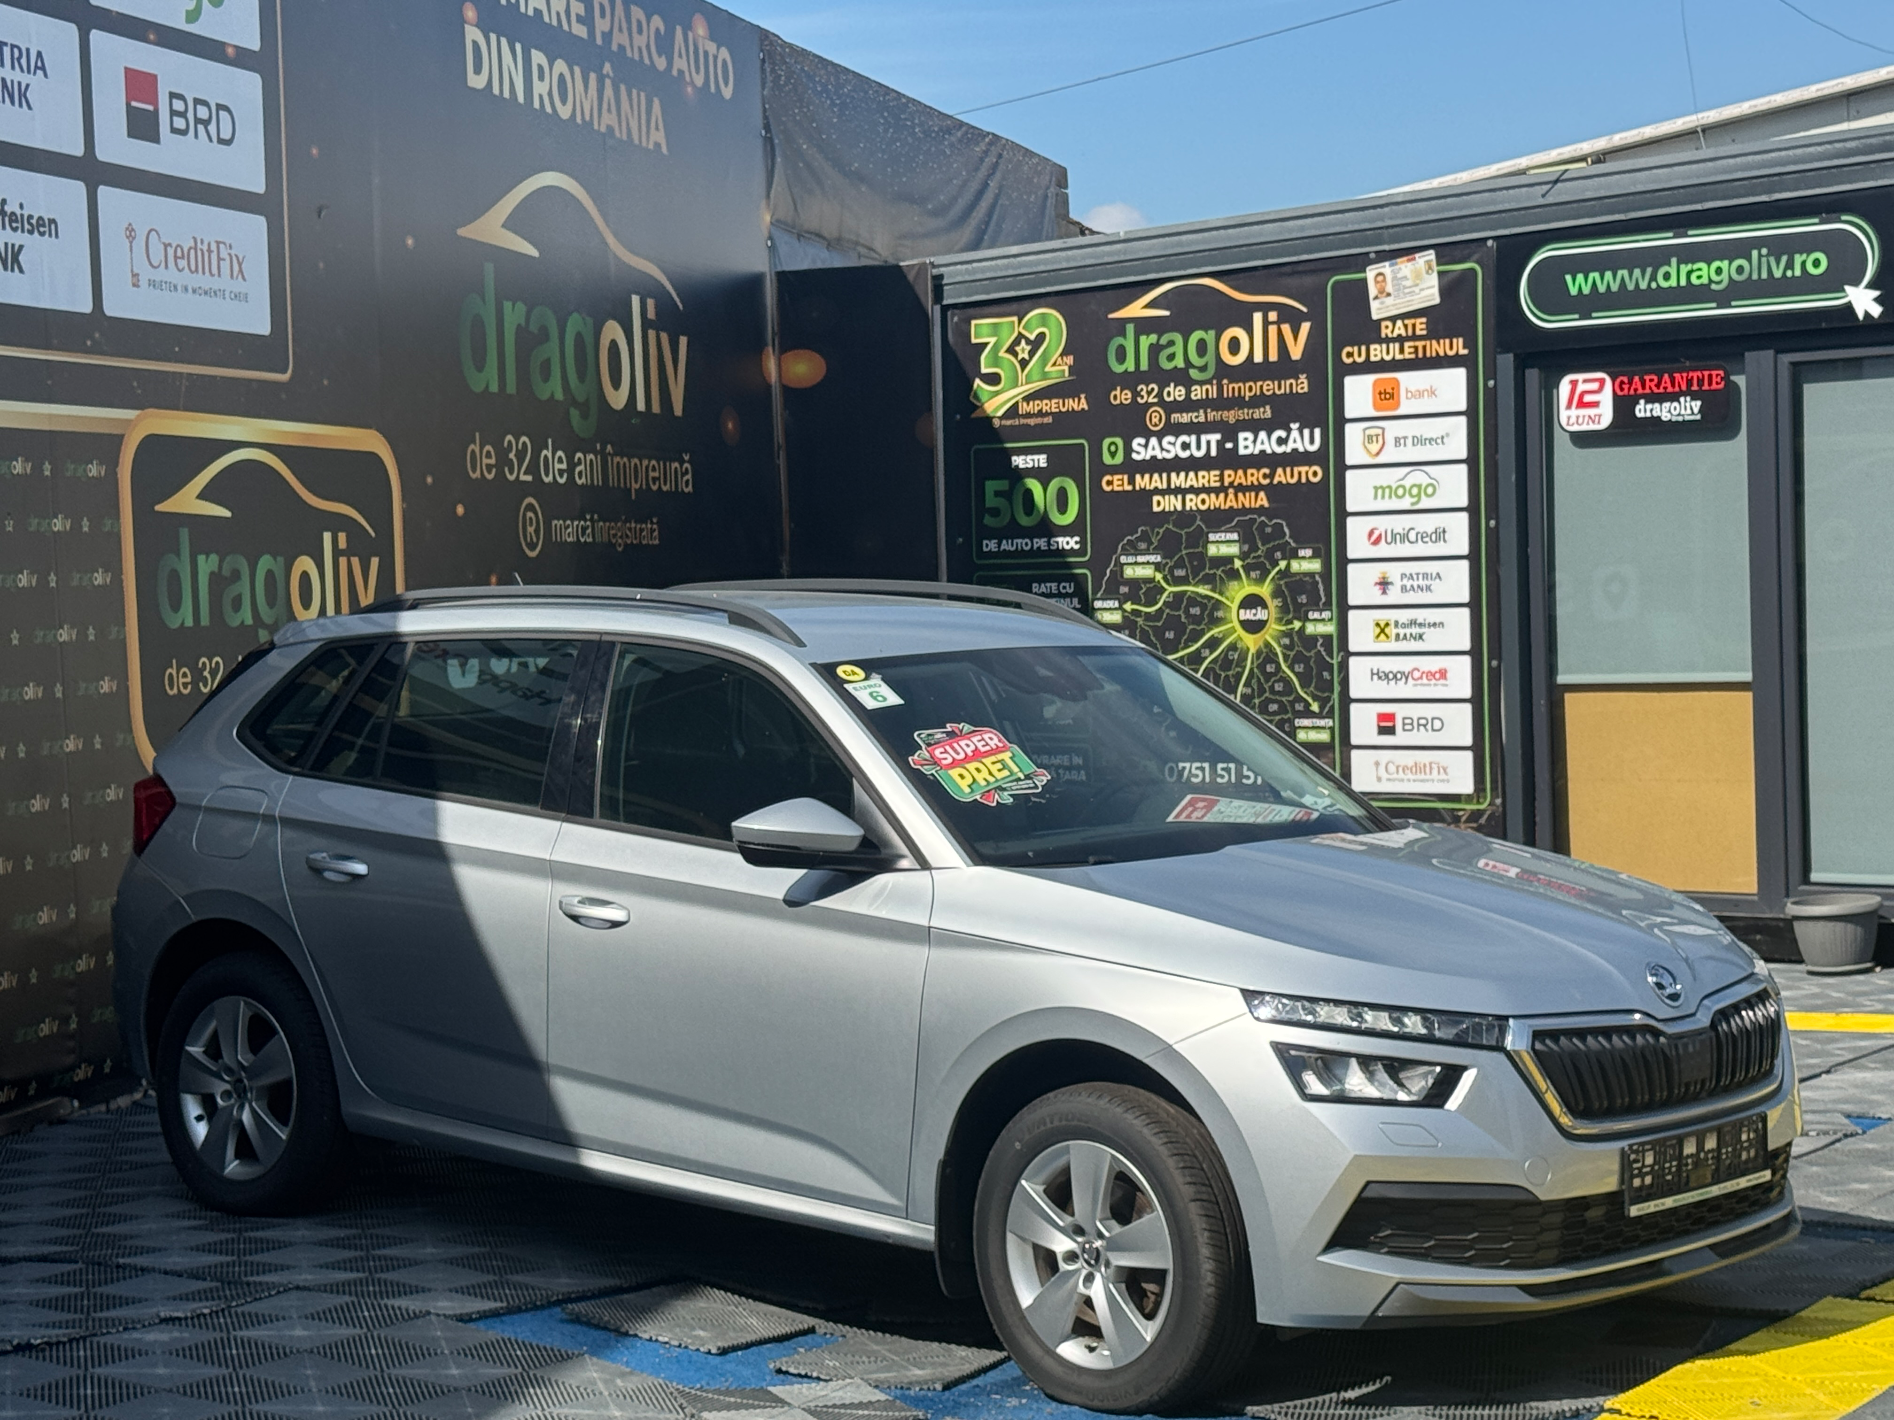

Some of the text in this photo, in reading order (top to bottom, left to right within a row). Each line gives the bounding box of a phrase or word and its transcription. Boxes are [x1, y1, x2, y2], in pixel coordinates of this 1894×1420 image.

[594, 0, 667, 72] PARC
[672, 25, 734, 100] AUTO
[464, 24, 668, 156] DIN ROMÂNIA
[168, 90, 237, 147] BRD
[145, 227, 247, 283] CreditFix
[1564, 247, 1829, 297] www.dragoliv.ro
[1380, 317, 1428, 339] RATE
[458, 262, 689, 439] dragoliv
[970, 307, 1067, 407] 32
[1107, 310, 1312, 381] dragoliv
[1341, 337, 1469, 365] CU BULETINUL
[1055, 354, 1074, 367] ANI
[1109, 373, 1309, 405] de 32 de ani împreună
[1378, 385, 1438, 402] tbi bank
[1565, 377, 1606, 411] 12
[1614, 369, 1726, 396] GARANTIE
[1018, 393, 1089, 415] ÎMPREUNĂ
[1170, 408, 1205, 424] marcă
[1206, 404, 1272, 424] înregistrată
[1634, 395, 1703, 422] dragoliv
[1566, 413, 1603, 427] LUNI
[1131, 432, 1221, 461] SASCUT
[1237, 422, 1322, 456] BACĂU
[1366, 433, 1381, 445] BT
[1394, 435, 1409, 448] BT
[467, 432, 694, 500] de 32 de ani împreună
[1011, 454, 1048, 469] PESTE
[1101, 465, 1323, 492] CEL MAI MARE PARC AUTO
[983, 476, 1080, 529] 500
[1152, 488, 1270, 513] DIN ROMÂNIA
[1372, 481, 1438, 507] mogo
[552, 514, 593, 544] marcă
[1384, 526, 1448, 546] UniCredit
[982, 536, 1081, 552] DE AUTO PE STOC
[157, 527, 380, 643] dragoliv
[1032, 582, 1075, 594] RATE CU
[1400, 571, 1443, 583] PATRIA
[1400, 583, 1434, 594] BANK
[1393, 617, 1445, 630] Raiffeisen
[1394, 631, 1427, 643] BANK
[163, 655, 224, 696] de 32
[851, 682, 882, 692] EURO
[1370, 667, 1449, 686] HappyCredit
[868, 690, 888, 703] 6
[1402, 716, 1445, 733] BRD
[934, 732, 1004, 766] SUPER
[1164, 761, 1211, 785] 0751
[1216, 761, 1236, 784] 51
[1384, 759, 1450, 777] CreditFix
